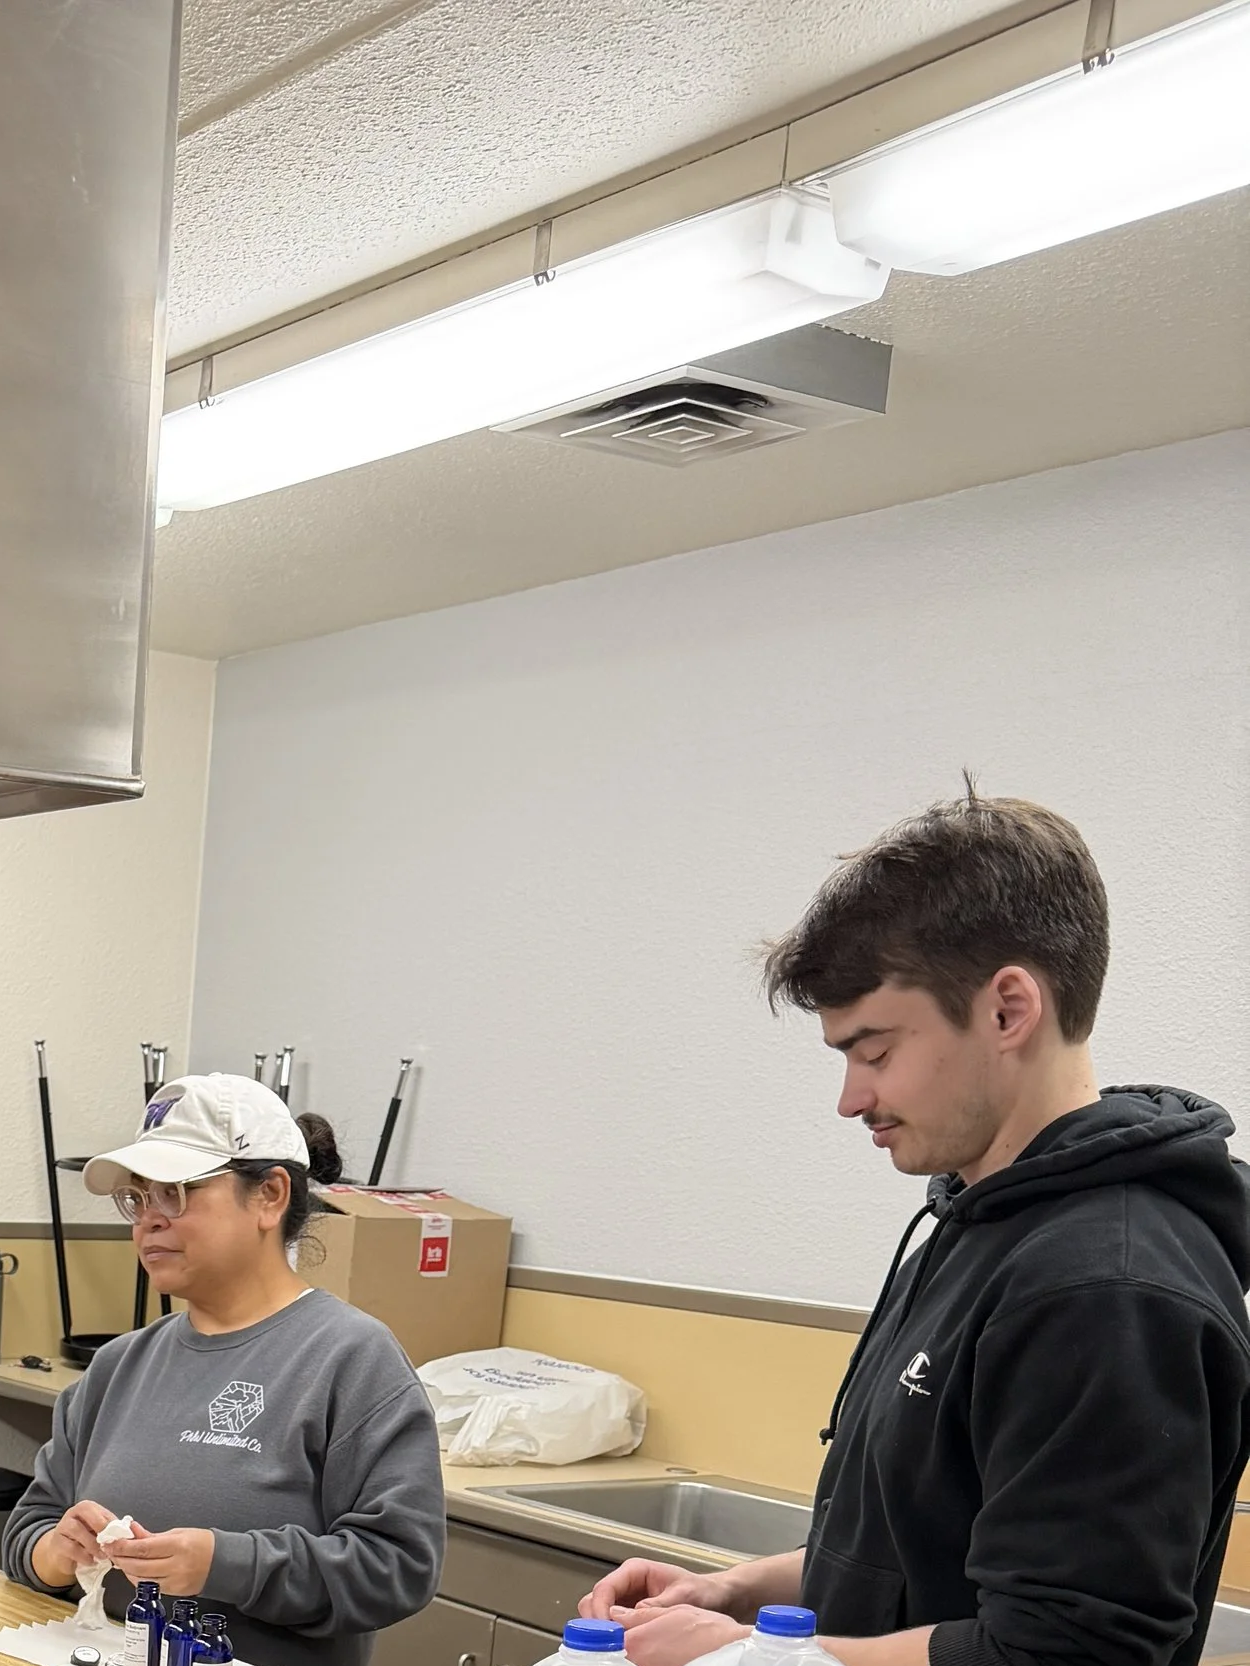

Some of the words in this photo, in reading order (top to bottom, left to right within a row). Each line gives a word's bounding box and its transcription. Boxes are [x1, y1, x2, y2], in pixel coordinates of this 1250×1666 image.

[179, 1430, 206, 1443] PNW
[202, 1431, 250, 1448] Unlimited
[247, 1438, 262, 1454] Co.
